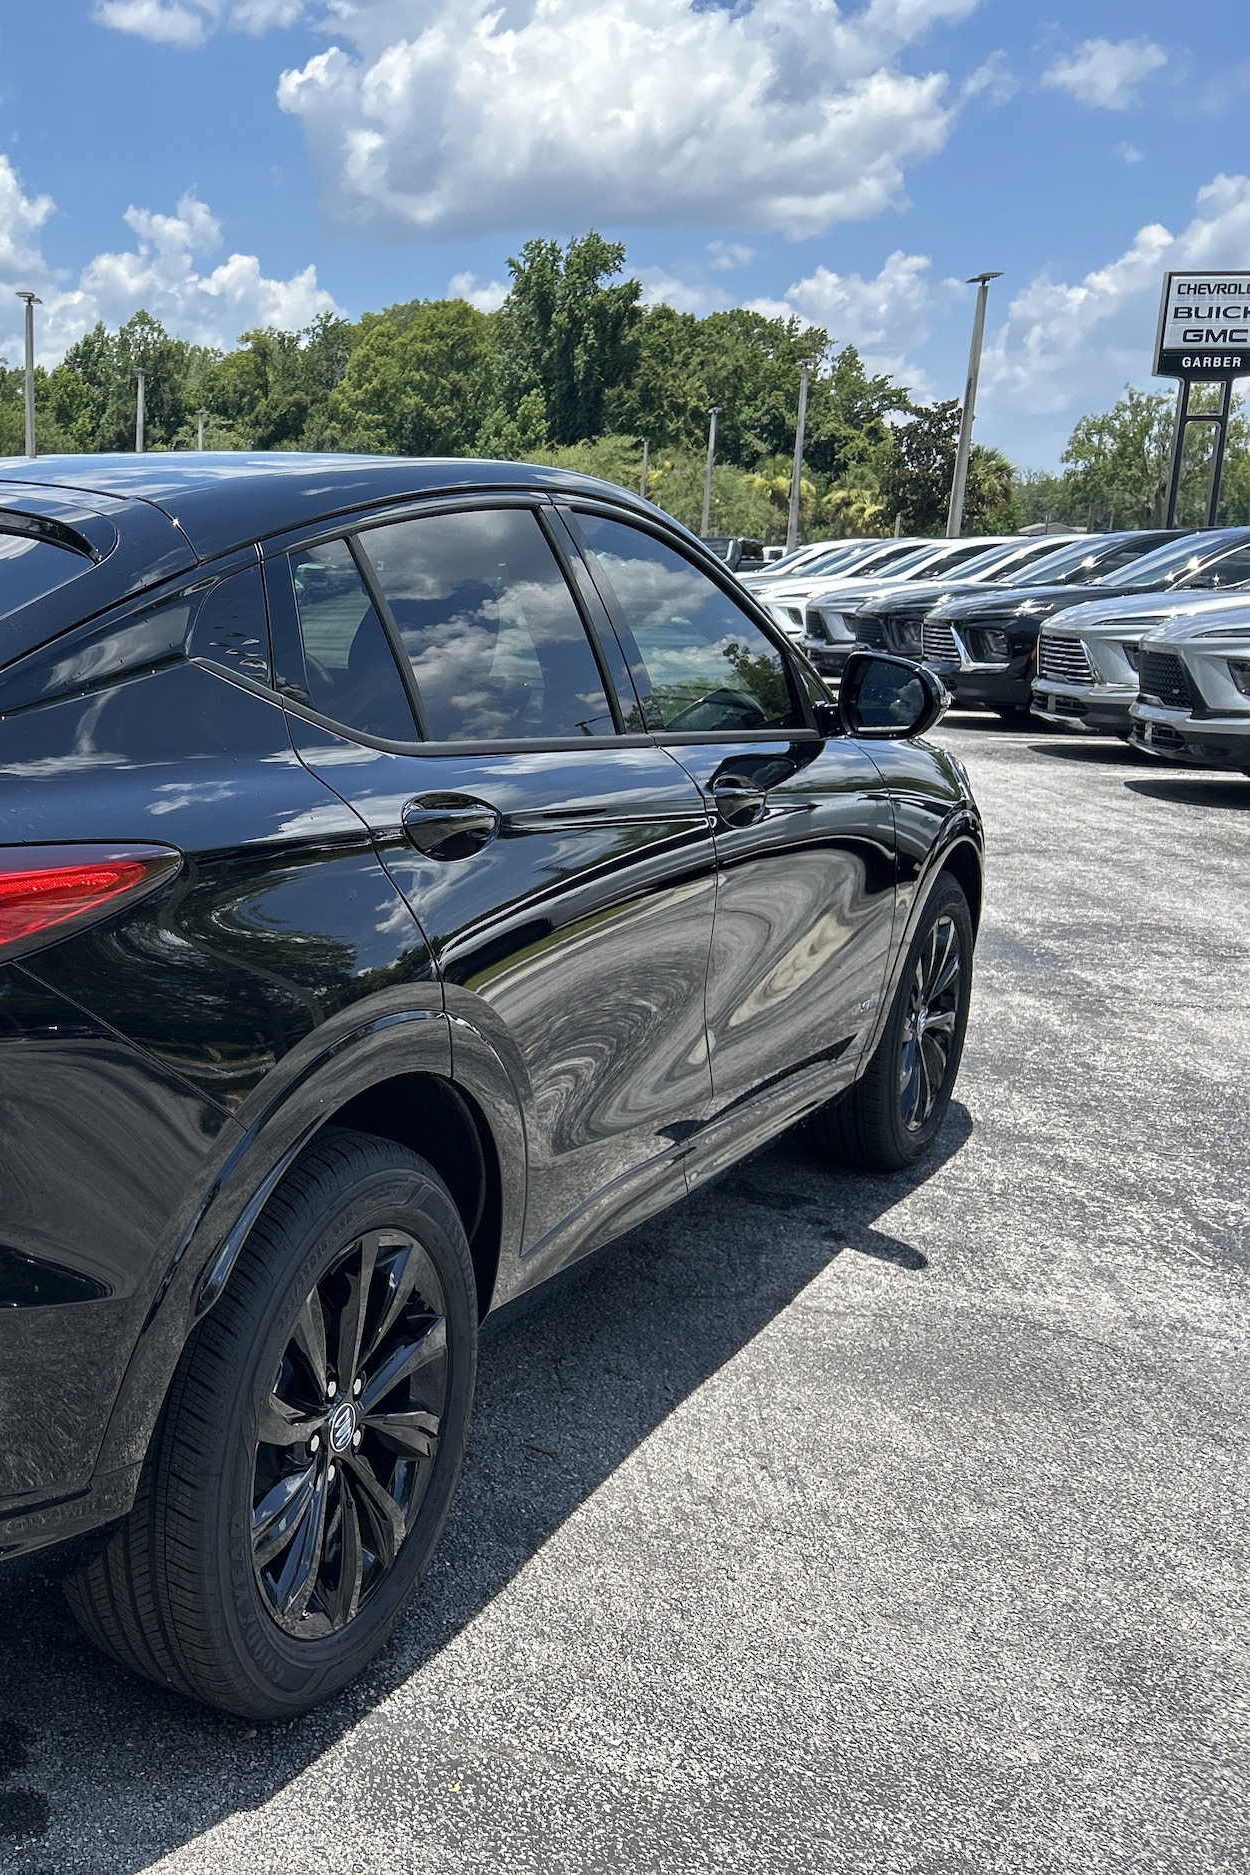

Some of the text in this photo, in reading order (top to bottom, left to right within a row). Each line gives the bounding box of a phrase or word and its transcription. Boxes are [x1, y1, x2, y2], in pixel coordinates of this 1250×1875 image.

[1182, 328, 1249, 343] GMC
[1181, 356, 1242, 368] GARBER
[229, 1510, 287, 1684] GOODYEAR
